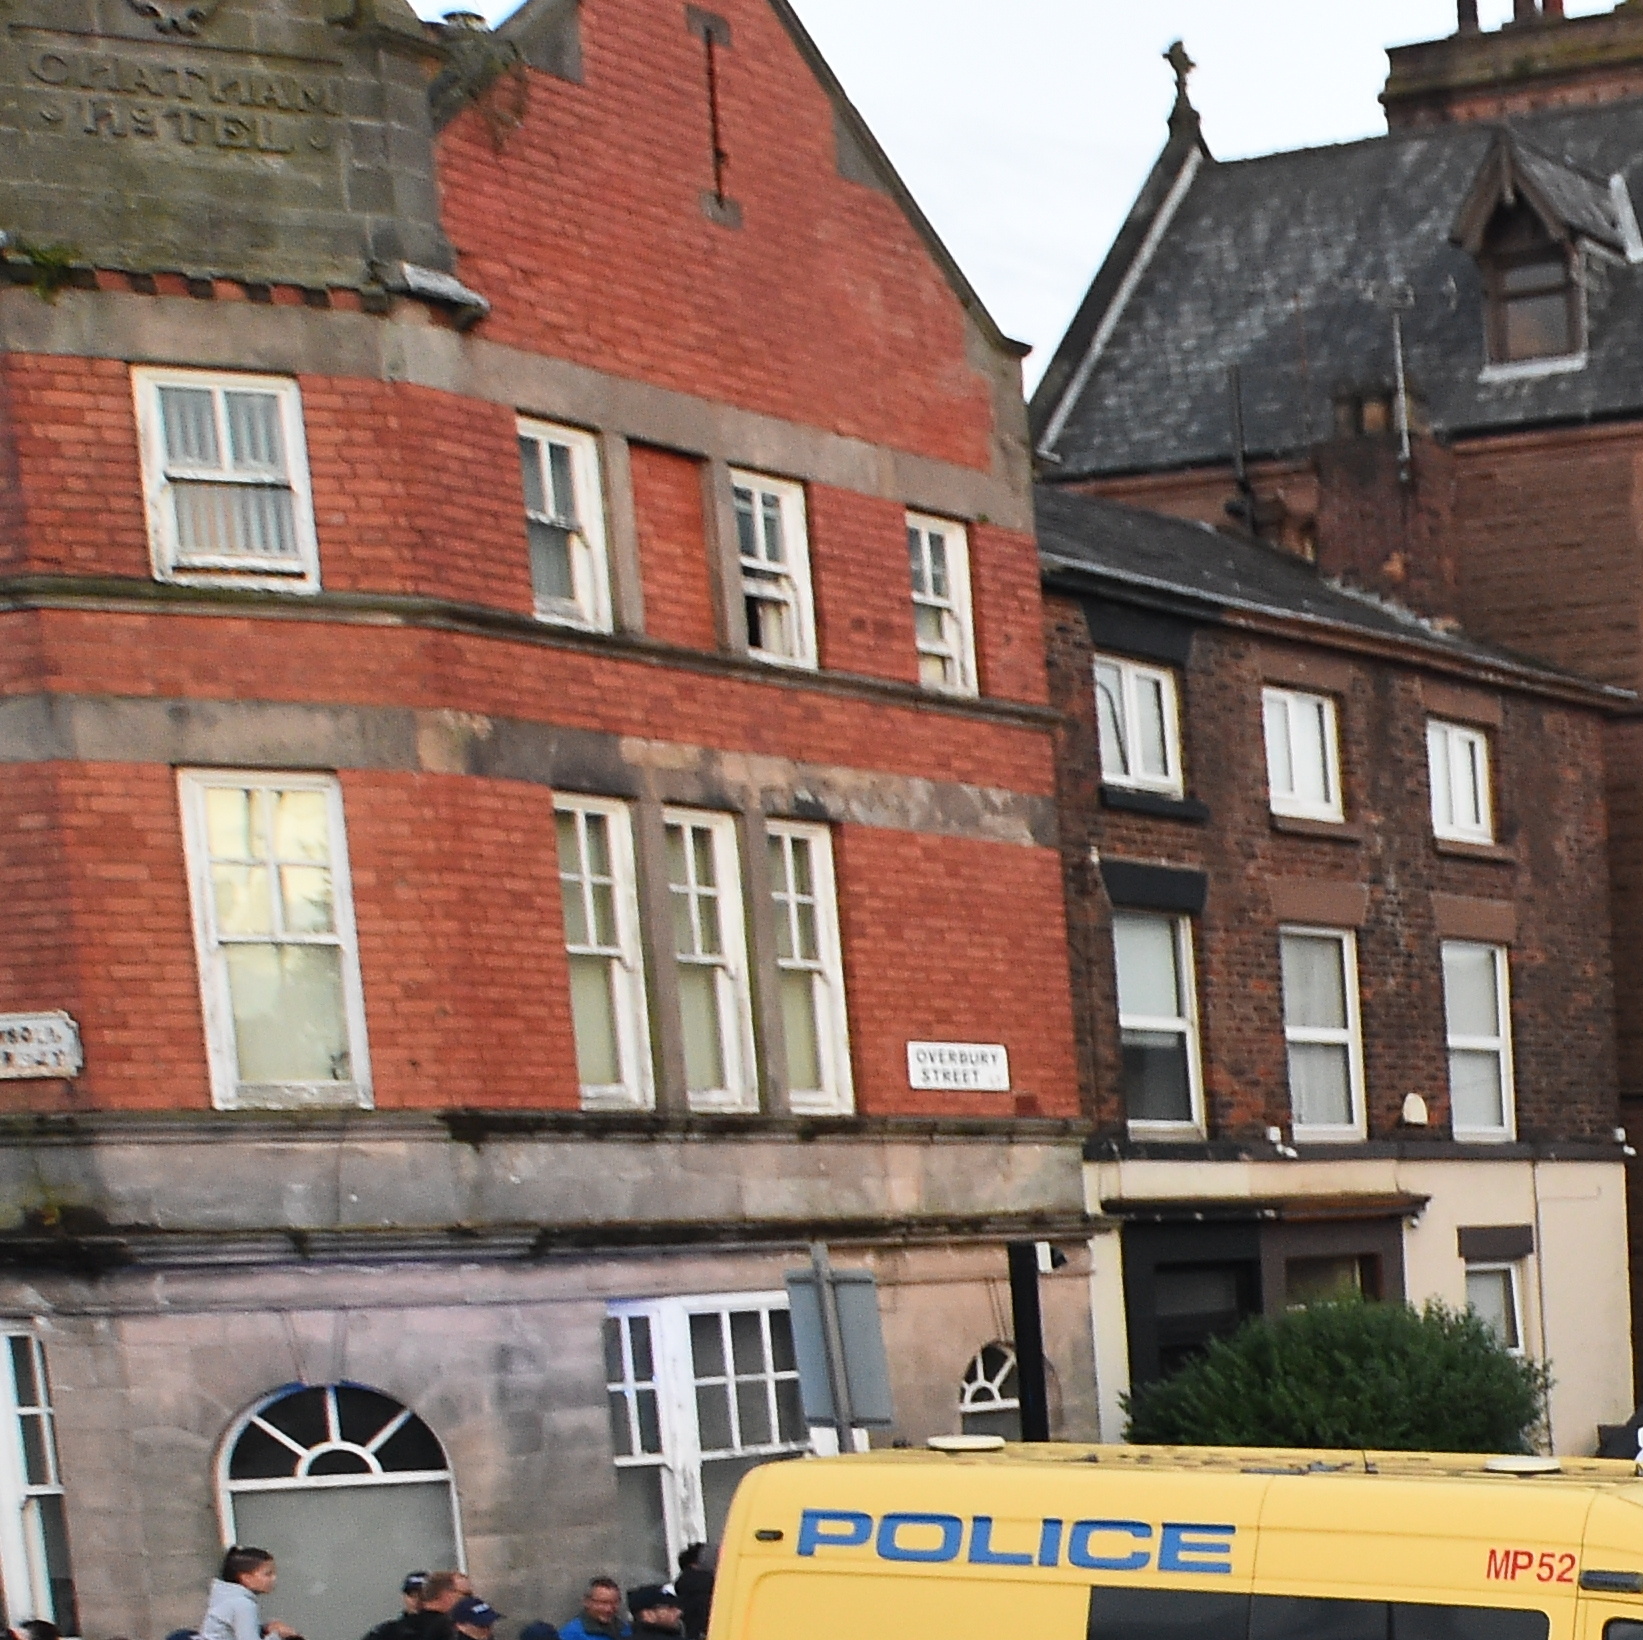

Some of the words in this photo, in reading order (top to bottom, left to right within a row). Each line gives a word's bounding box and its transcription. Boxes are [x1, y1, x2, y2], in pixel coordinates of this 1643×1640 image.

[29, 52, 343, 118] CHATHAM
[916, 1047, 997, 1065] OVERBURY
[922, 1068, 979, 1083] STREET
[797, 1509, 1236, 1574] POLICE
[1487, 1549, 1576, 1582] MP52
